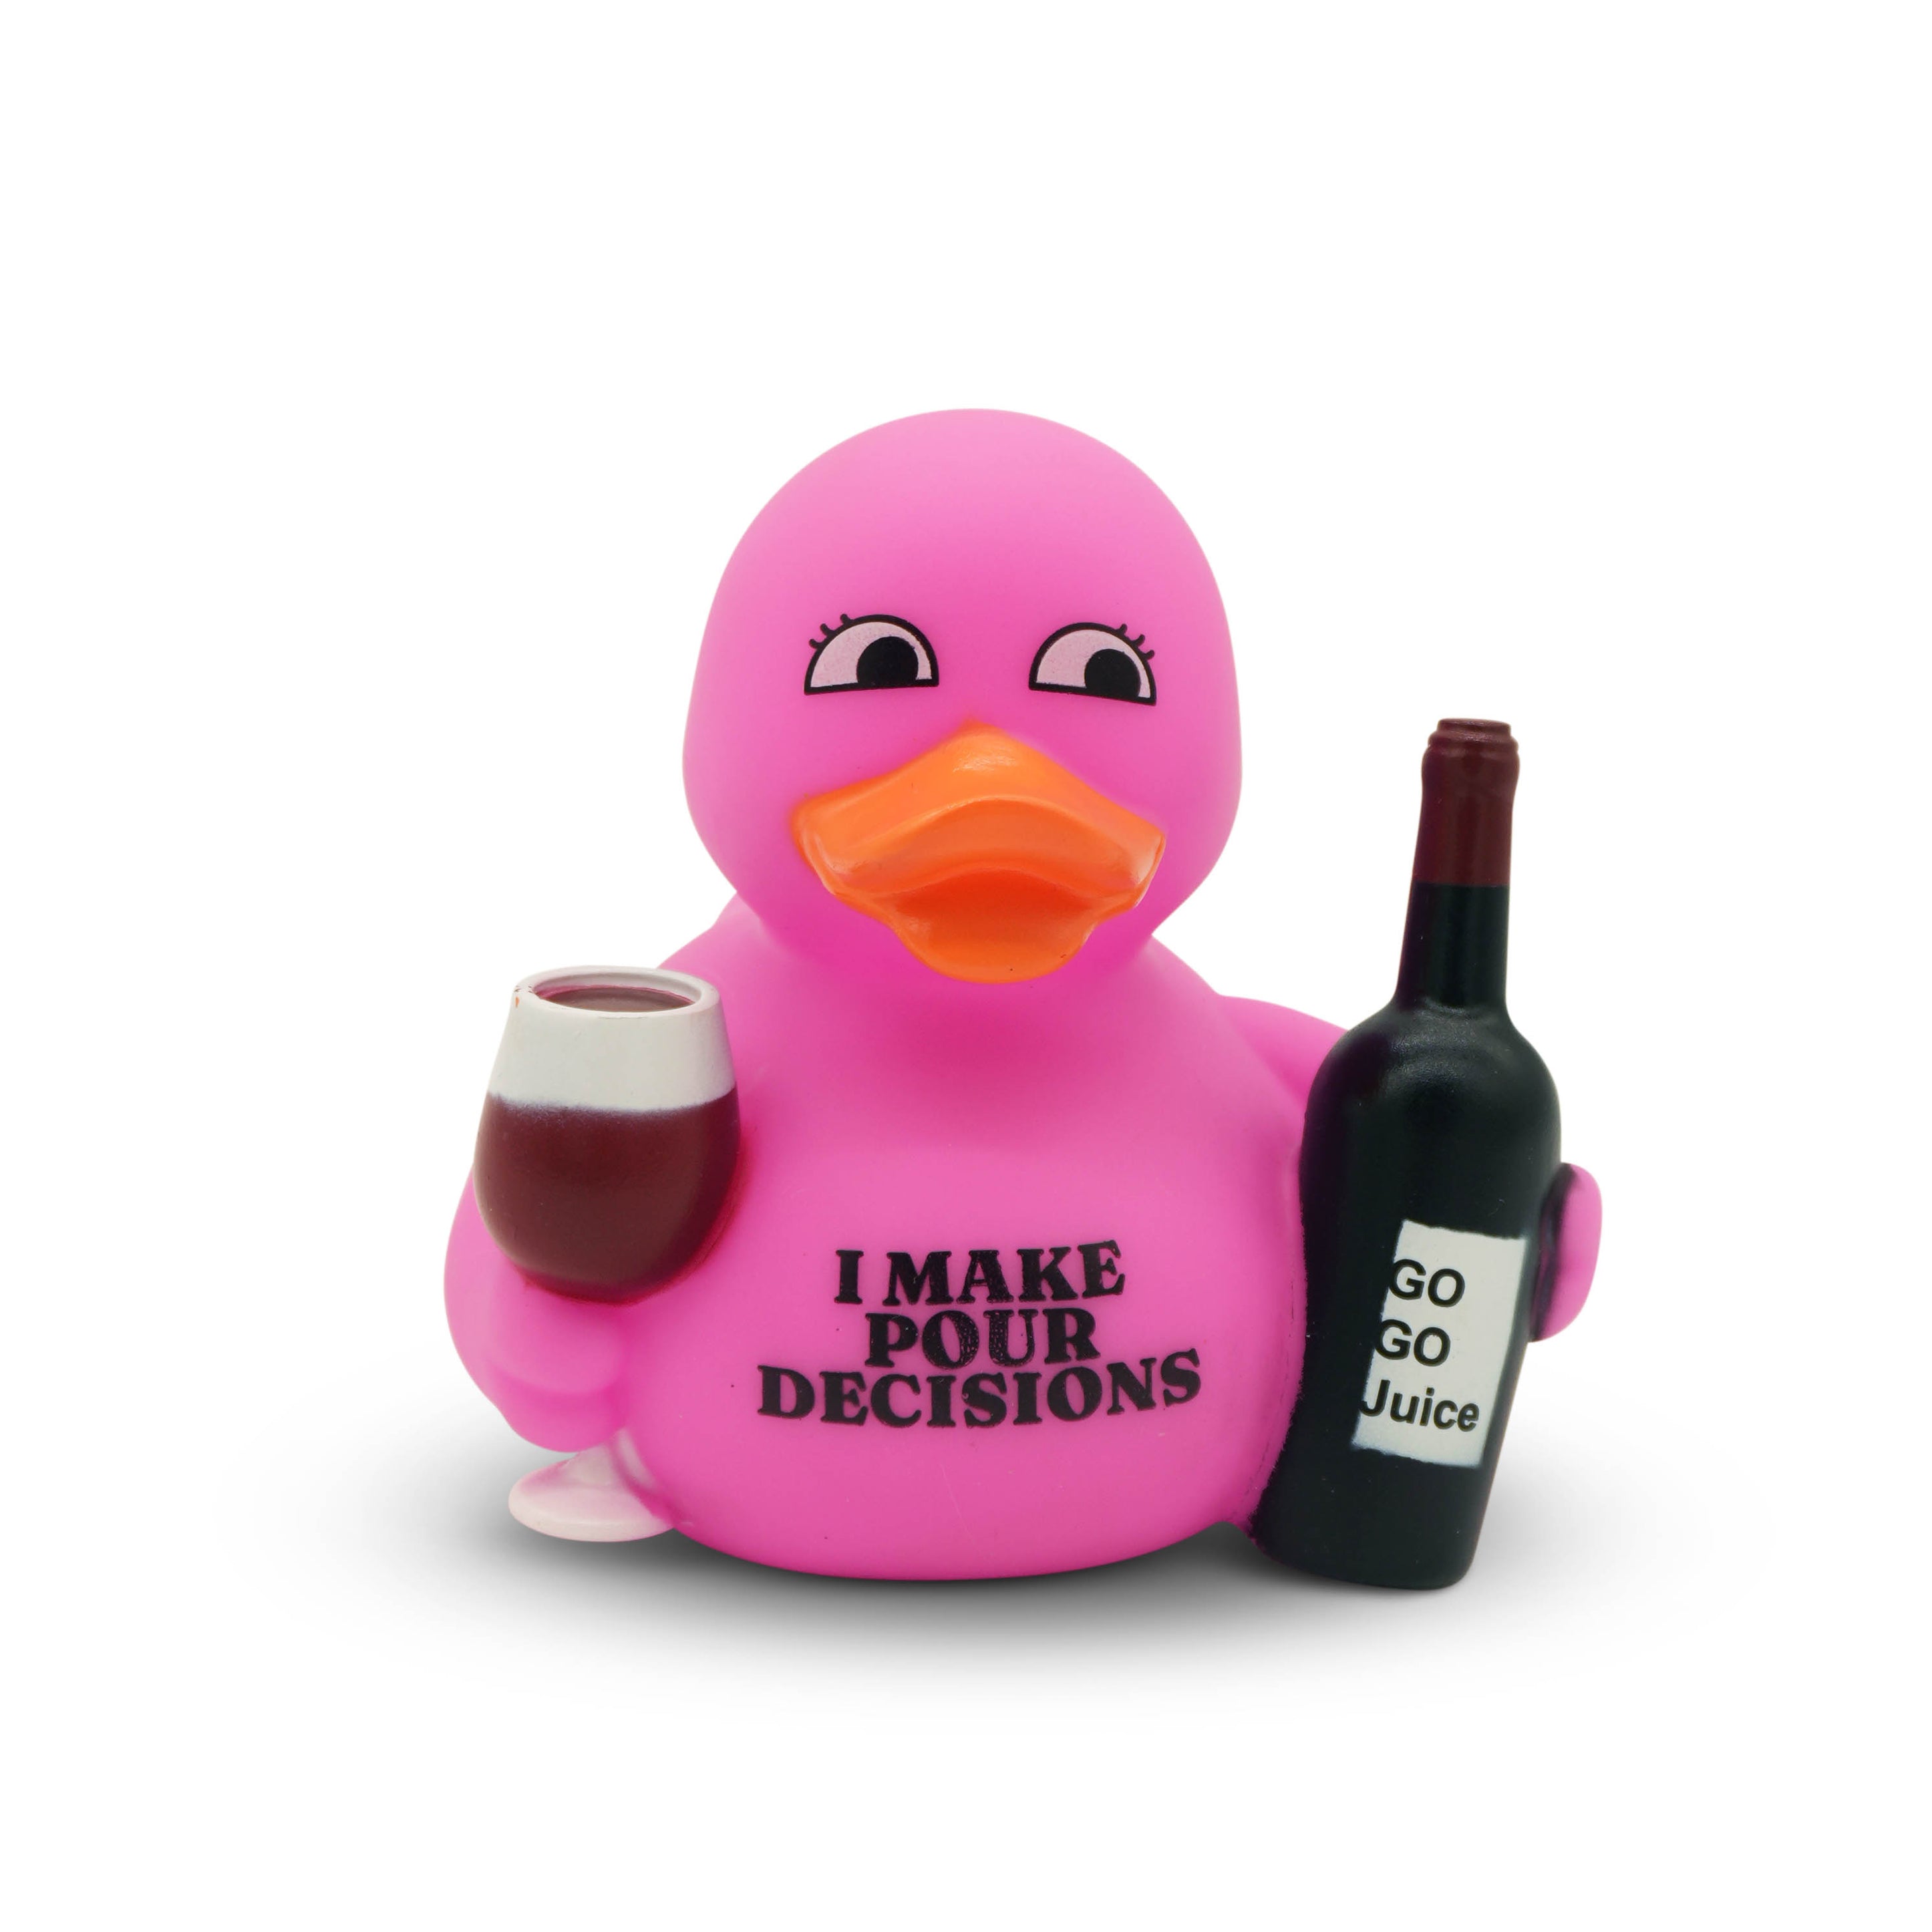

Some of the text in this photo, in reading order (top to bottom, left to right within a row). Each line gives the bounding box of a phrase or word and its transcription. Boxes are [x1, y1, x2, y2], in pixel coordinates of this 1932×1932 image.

[834, 1240, 1125, 1306] I MAKE
[1389, 1259, 1466, 1307] GO
[864, 1307, 1101, 1370] POUR
[1374, 1319, 1451, 1367] GO
[757, 1348, 1202, 1428] DECISIONS
[1359, 1380, 1480, 1432] Juice
